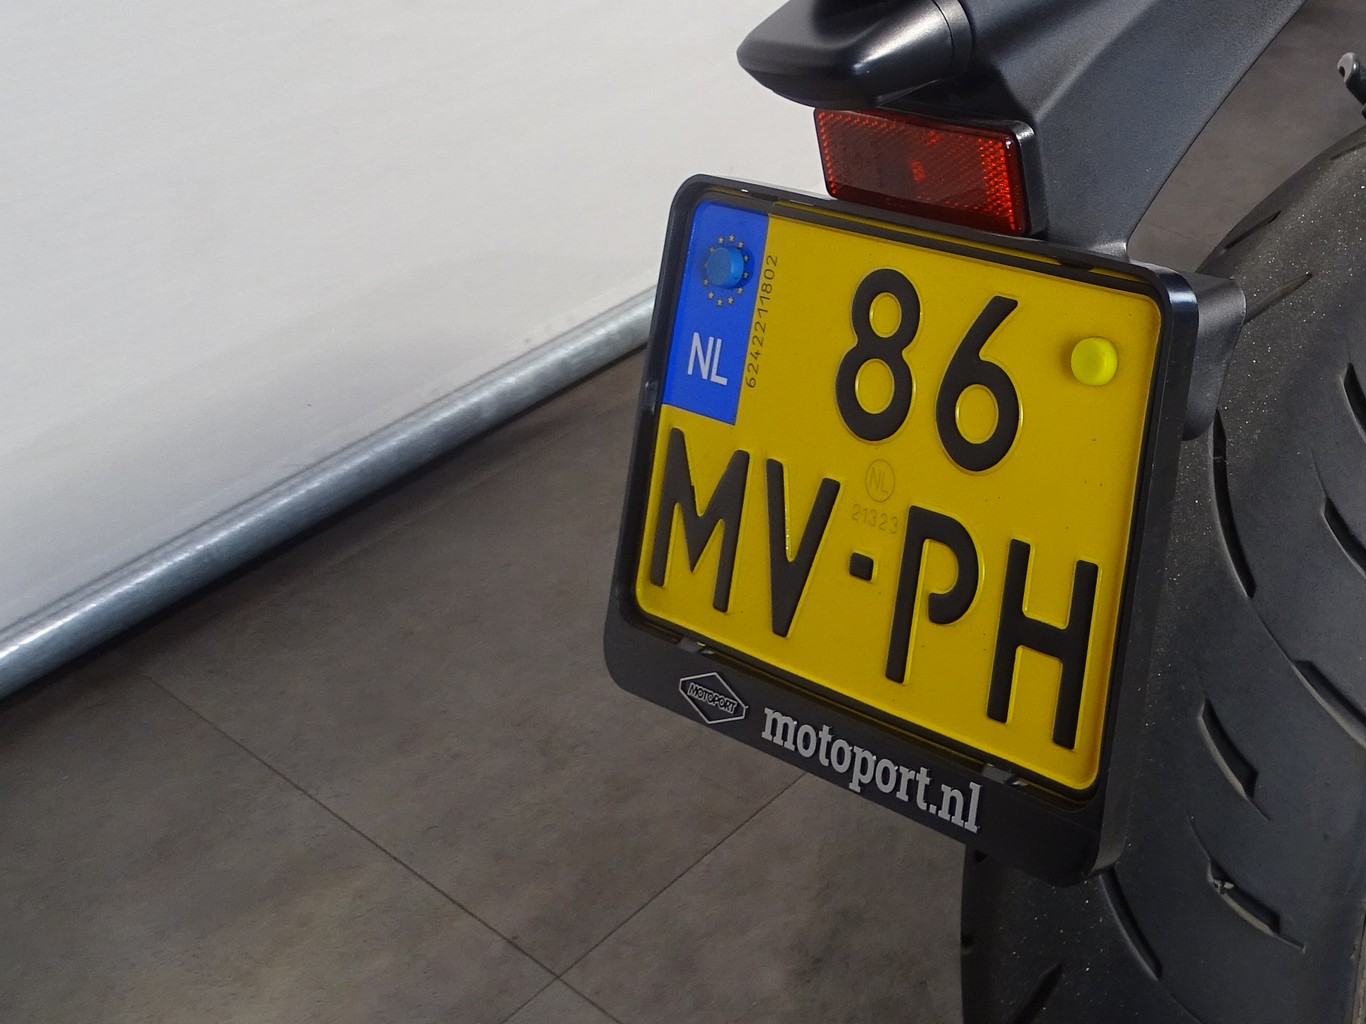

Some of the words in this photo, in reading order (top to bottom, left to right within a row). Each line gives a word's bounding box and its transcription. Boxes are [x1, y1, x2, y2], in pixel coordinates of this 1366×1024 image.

[687, 332, 728, 386] NL
[746, 255, 778, 388] 6242211802
[834, 268, 1023, 472] 86
[852, 503, 899, 534] 21323
[869, 466, 889, 494] NL
[649, 427, 1100, 750] MV-PH
[687, 682, 738, 714] MOTOPORT
[761, 707, 982, 833] motoport.nl
